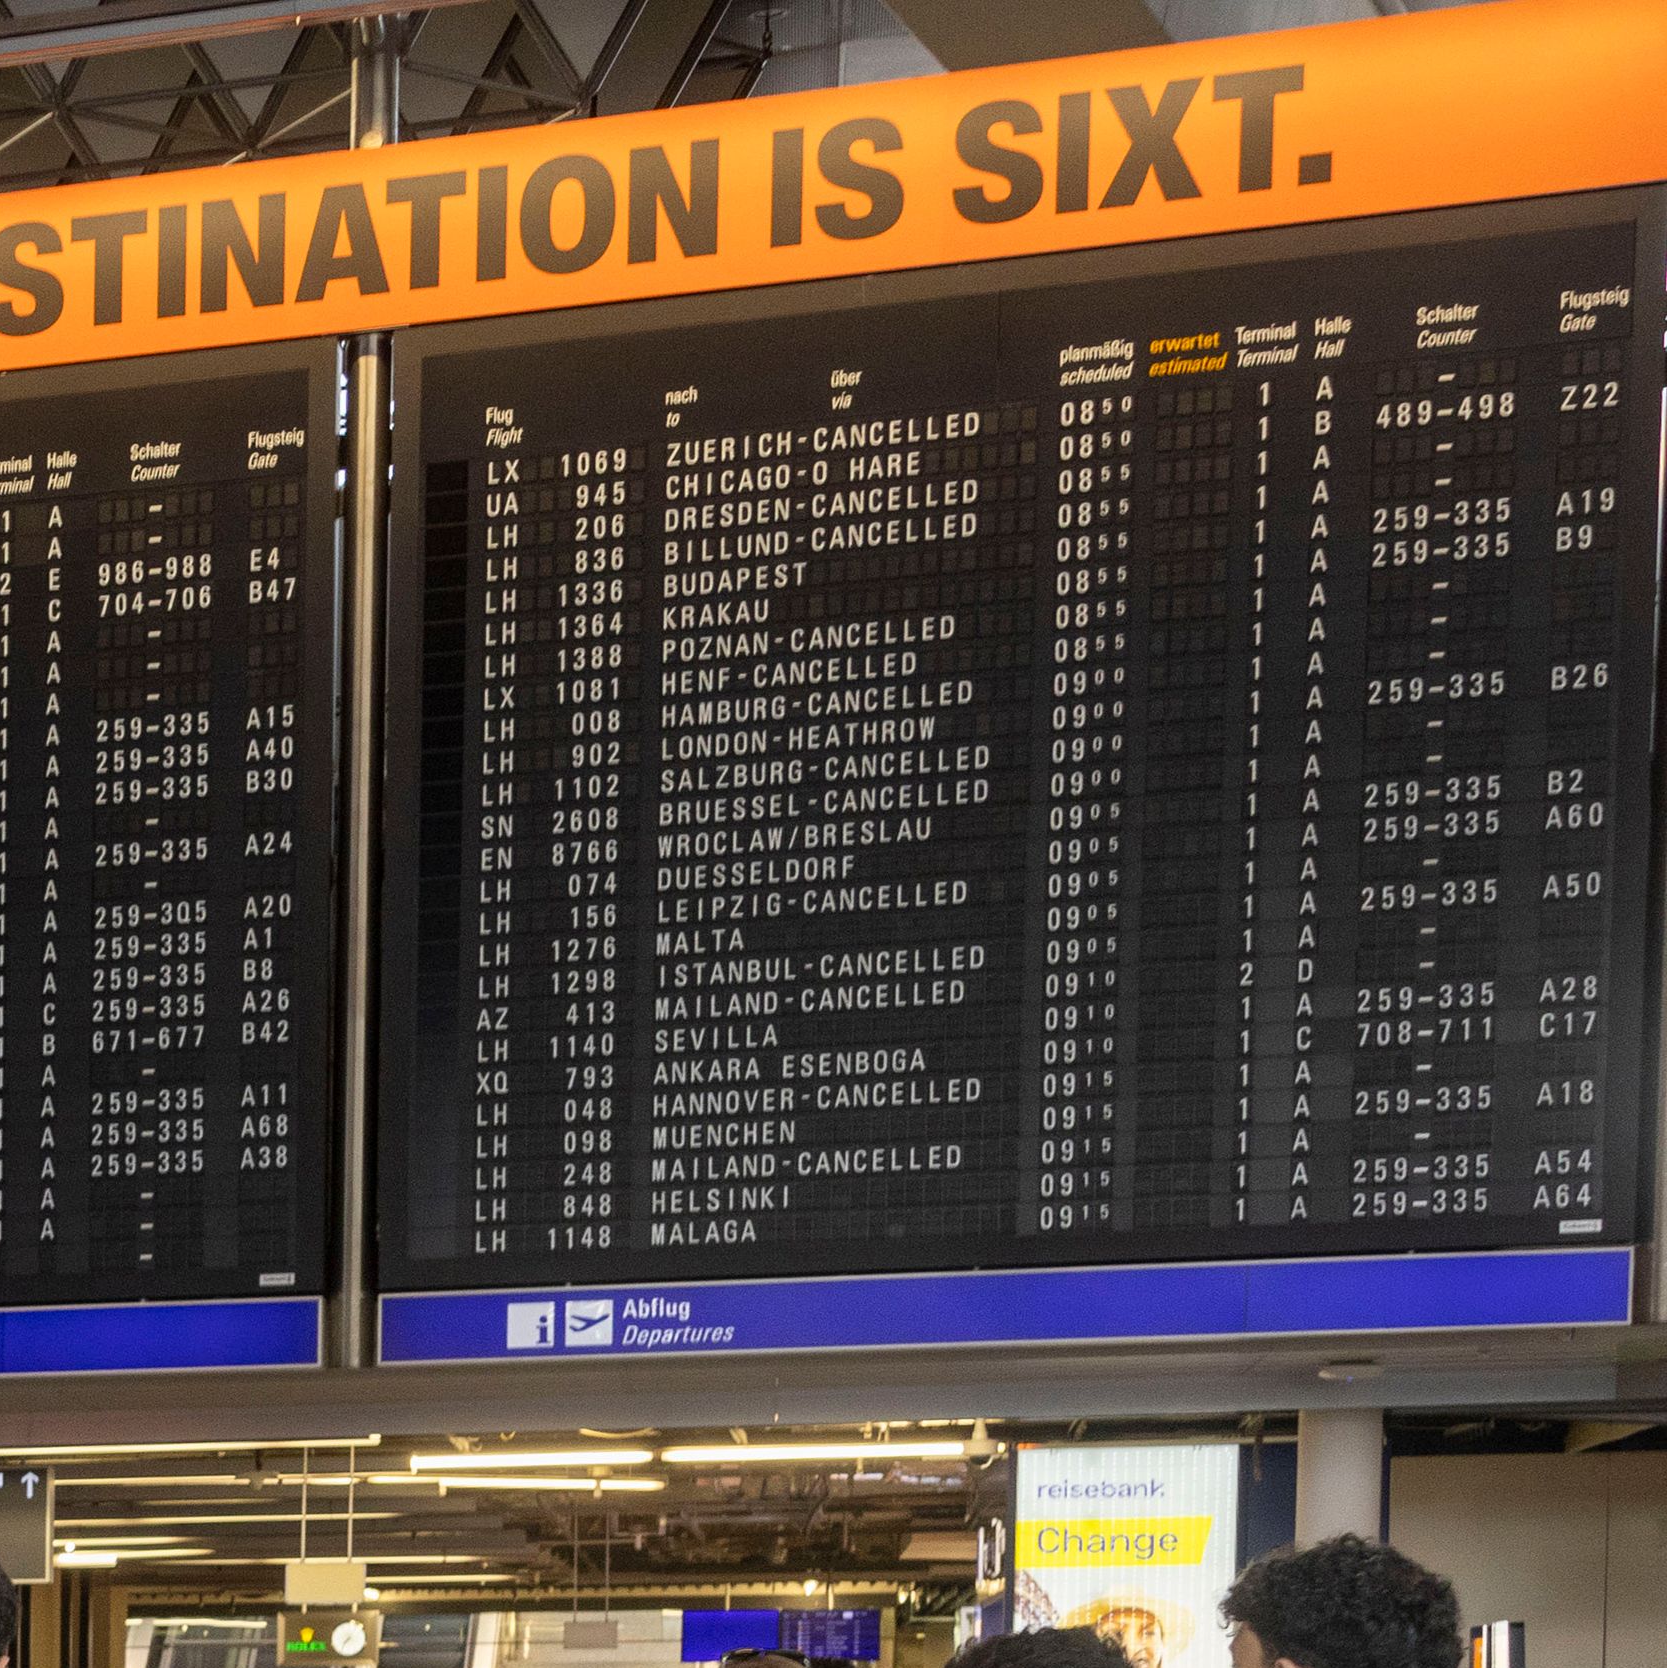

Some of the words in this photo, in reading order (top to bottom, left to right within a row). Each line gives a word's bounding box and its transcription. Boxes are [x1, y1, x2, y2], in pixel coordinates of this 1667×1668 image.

[770, 119, 904, 248] IS
[952, 66, 1333, 225] SIXT.
[1416, 303, 1480, 326] Schalter
[1559, 288, 1630, 312] Flugsteig
[1558, 312, 1597, 334] Gate
[1059, 338, 1135, 368] planmäßig
[1416, 328, 1478, 349] Counter
[1059, 360, 1135, 387] scheduled
[486, 491, 520, 518] UA
[575, 480, 626, 510] 945
[665, 459, 829, 501] CHICAGO-O
[849, 450, 920, 482] HARE
[1375, 391, 1515, 429] 489-498
[1559, 380, 1619, 412] Z22
[665, 411, 981, 468] ZUERICH-CANCELLED
[98, 552, 212, 587] 986-988
[249, 546, 281, 572] E4
[661, 651, 917, 696] HENF-CANCELLED
[657, 816, 932, 859] WROCLAW/BRESLAU
[92, 1024, 205, 1054] 671-677
[241, 1019, 289, 1045] B42
[654, 1023, 778, 1053] SEVILLA
[476, 1069, 509, 1095] XQ
[565, 1064, 614, 1090] 793
[652, 1056, 761, 1086] ANKARA
[782, 1047, 926, 1079] ESENBOGA
[1357, 1016, 1492, 1047] 708-711
[1539, 1009, 1597, 1038] C17
[650, 1218, 757, 1246] MALAGA
[622, 1297, 691, 1321] Abflug
[622, 1324, 735, 1348] Departures
[1037, 1479, 1166, 1500] reisebank
[1037, 1526, 1179, 1561] Change
